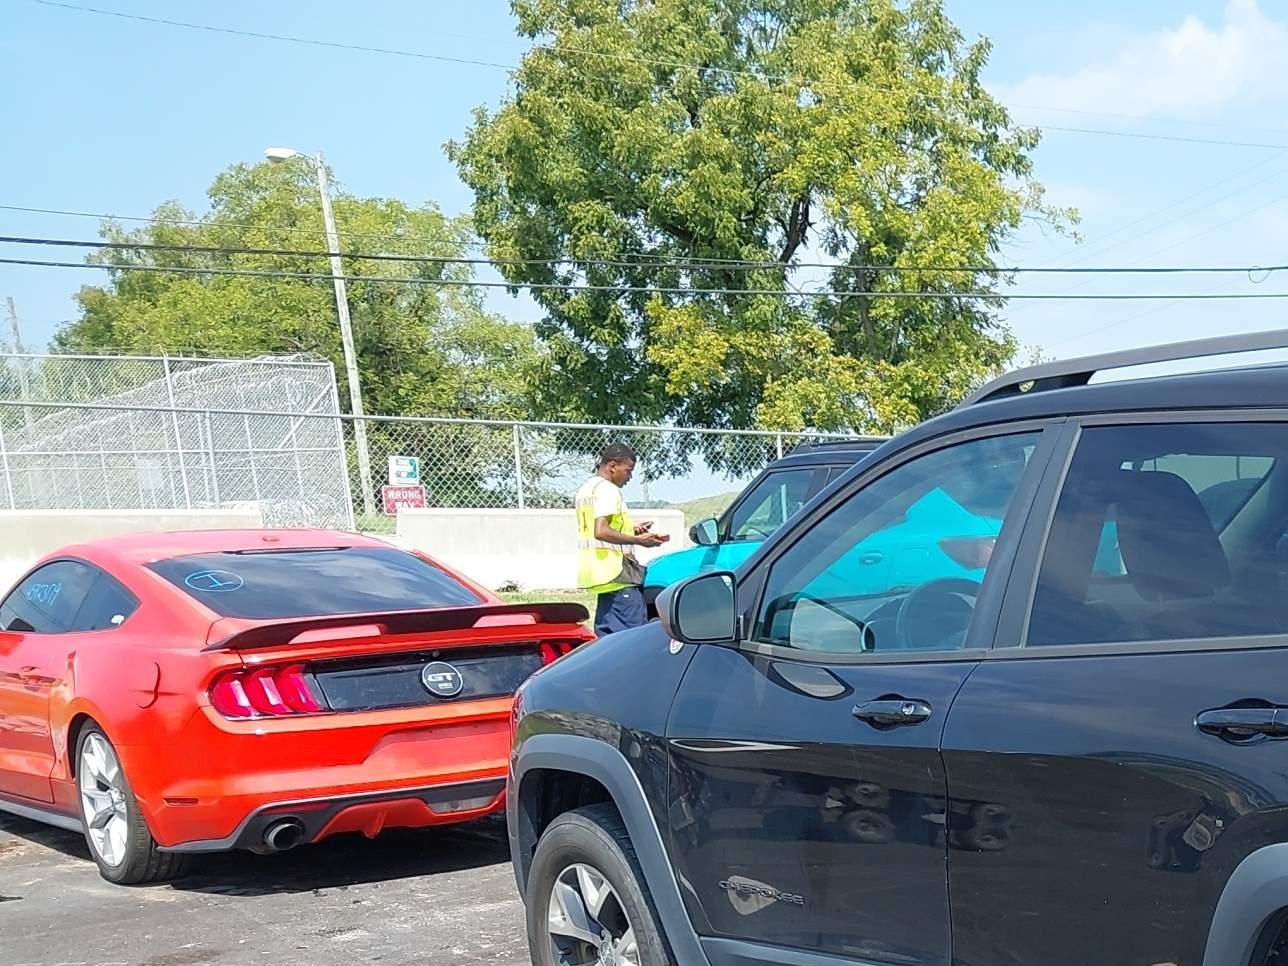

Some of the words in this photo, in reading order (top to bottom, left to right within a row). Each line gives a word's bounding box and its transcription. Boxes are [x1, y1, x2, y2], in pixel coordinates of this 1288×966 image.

[387, 490, 420, 499] WRONG
[428, 672, 456, 682] GT
[718, 880, 804, 905] CHEROKEE
